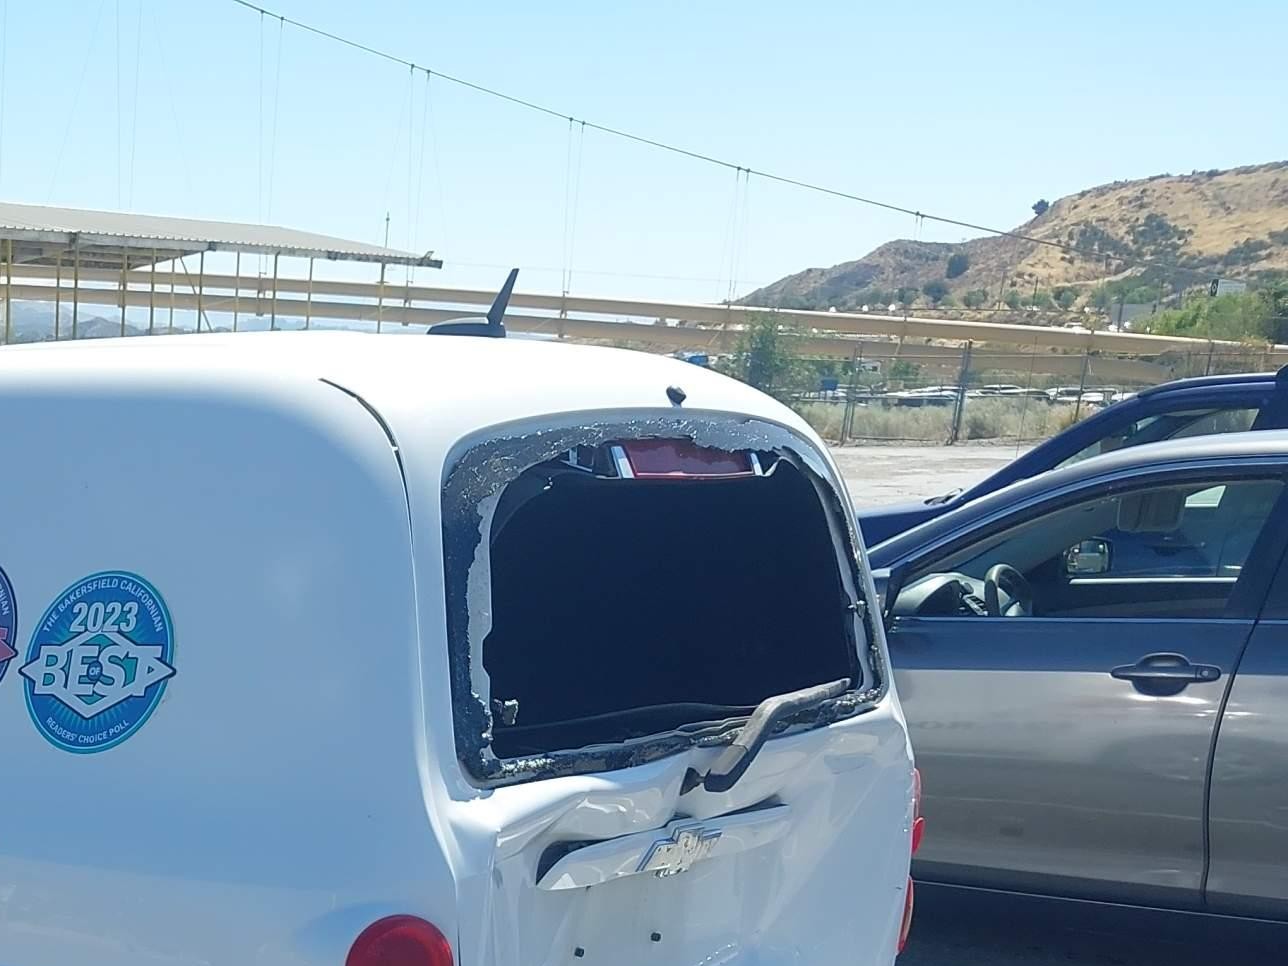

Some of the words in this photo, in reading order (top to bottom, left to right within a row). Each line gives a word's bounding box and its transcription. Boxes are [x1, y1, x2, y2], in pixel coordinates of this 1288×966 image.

[42, 612, 59, 633] THE
[58, 578, 119, 612] BAKERSFIELD
[120, 580, 164, 633] CALIFORNIAN
[69, 601, 139, 633] 2023
[33, 645, 163, 697] BEST
[88, 667, 101, 677] OF
[45, 716, 78, 742] READERS'
[78, 730, 108, 744] CHOICE
[109, 720, 130, 737] POLL
